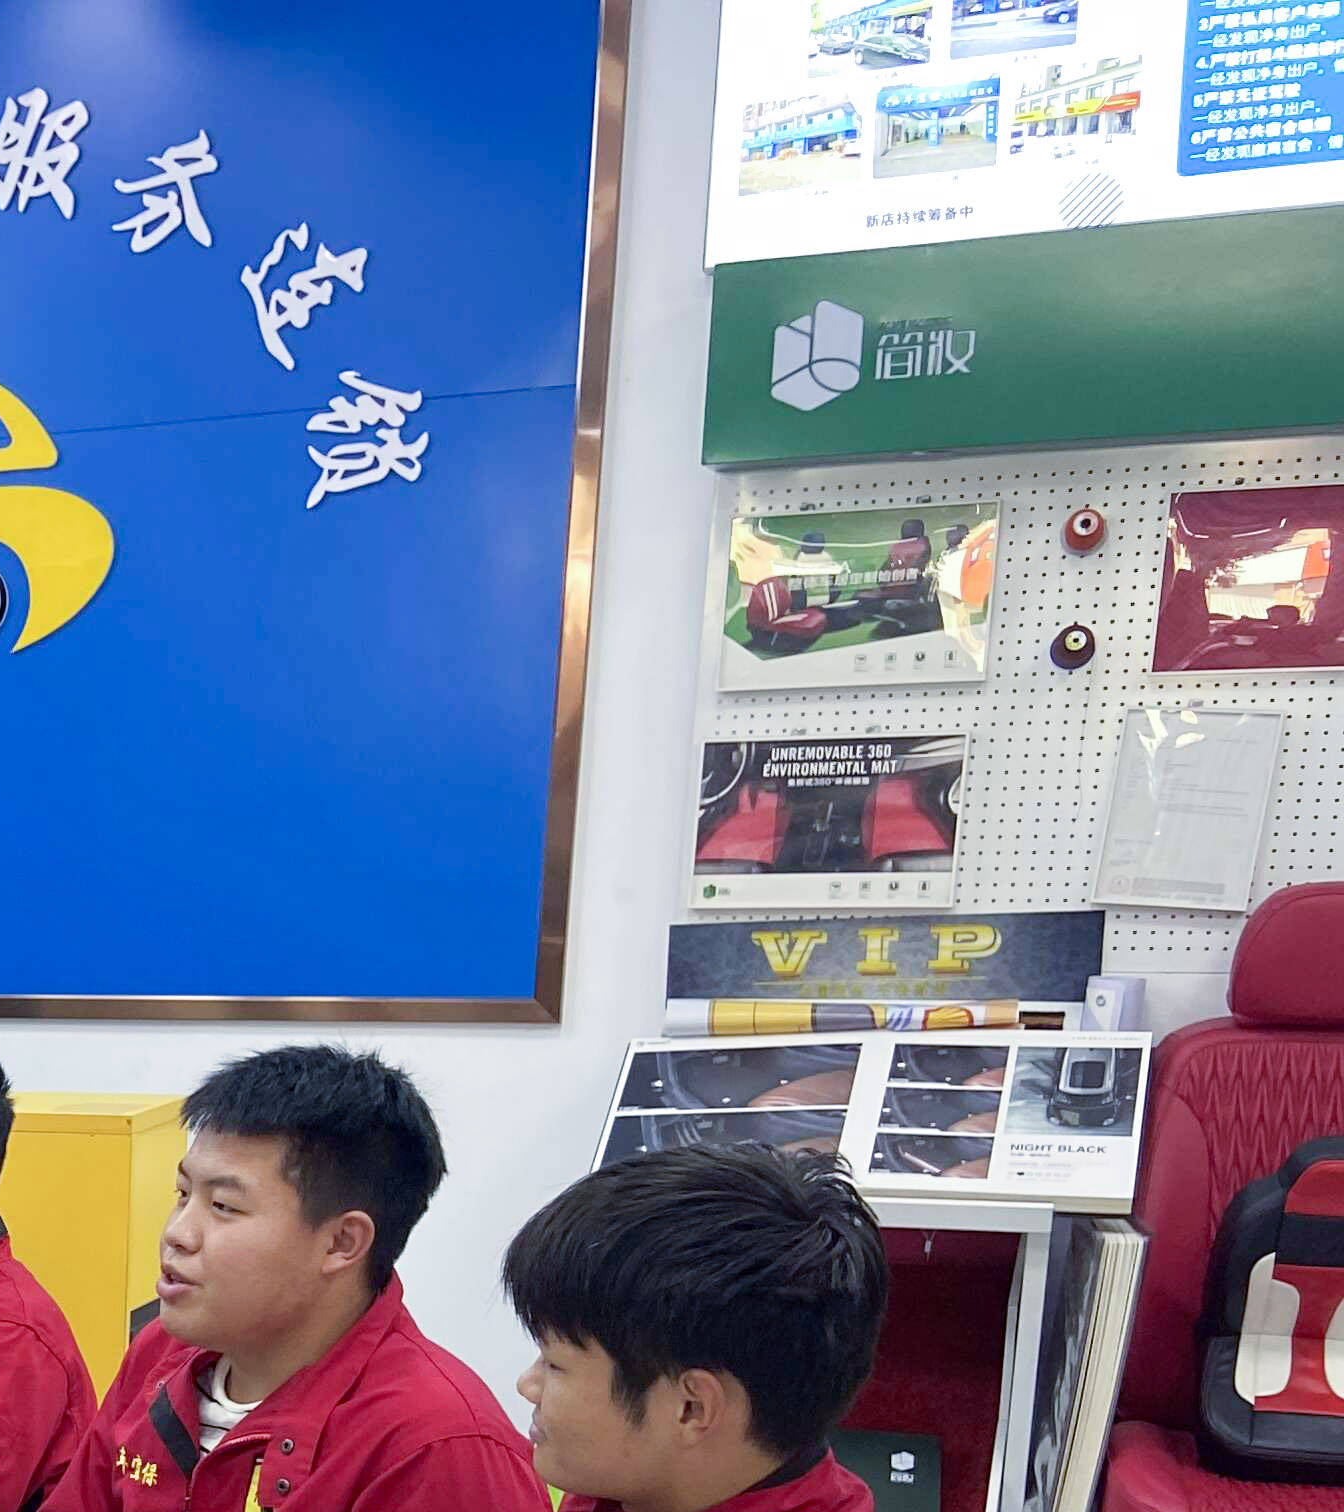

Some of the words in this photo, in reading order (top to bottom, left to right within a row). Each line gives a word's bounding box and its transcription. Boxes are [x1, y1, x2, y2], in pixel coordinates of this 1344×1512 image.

[865, 206, 975, 229] 新店持续筹备中
[770, 746, 864, 762] UNREMOVABLE
[867, 744, 892, 758] 360
[762, 763, 867, 778] ENVIRONMENTAL
[871, 759, 897, 774] MAT
[750, 923, 1004, 978] VIP
[1010, 1143, 1054, 1151] NIGHT
[1057, 1144, 1107, 1154] BLACK
